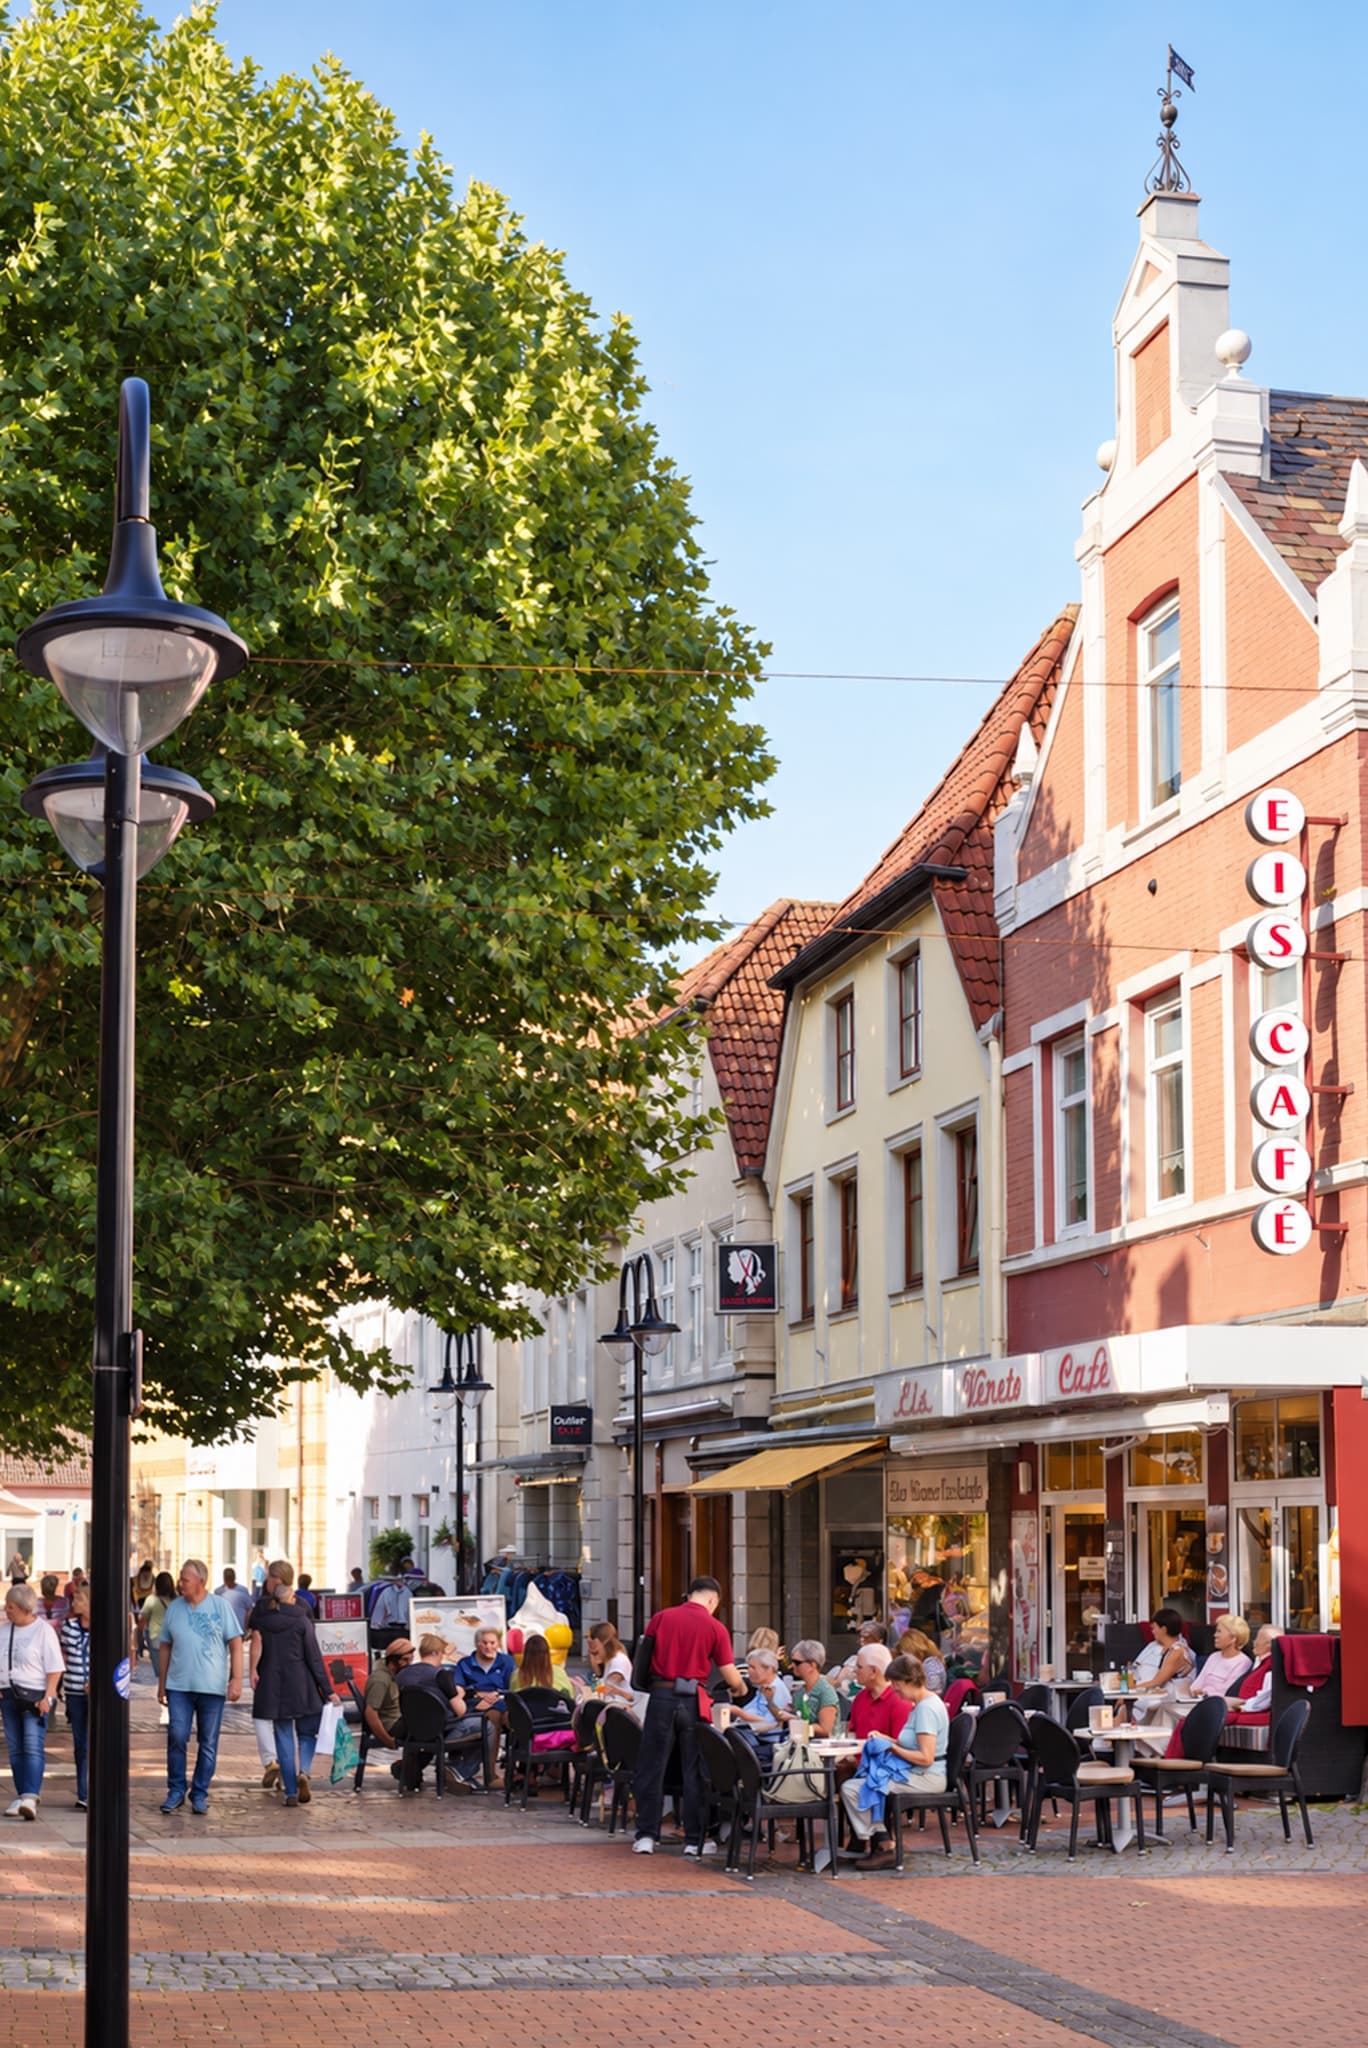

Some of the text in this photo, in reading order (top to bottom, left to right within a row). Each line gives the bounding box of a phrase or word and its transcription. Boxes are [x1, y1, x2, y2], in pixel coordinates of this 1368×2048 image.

[1267, 800, 1298, 1245] EIS CAFÉ
[962, 1367, 1022, 1409] Veneto
